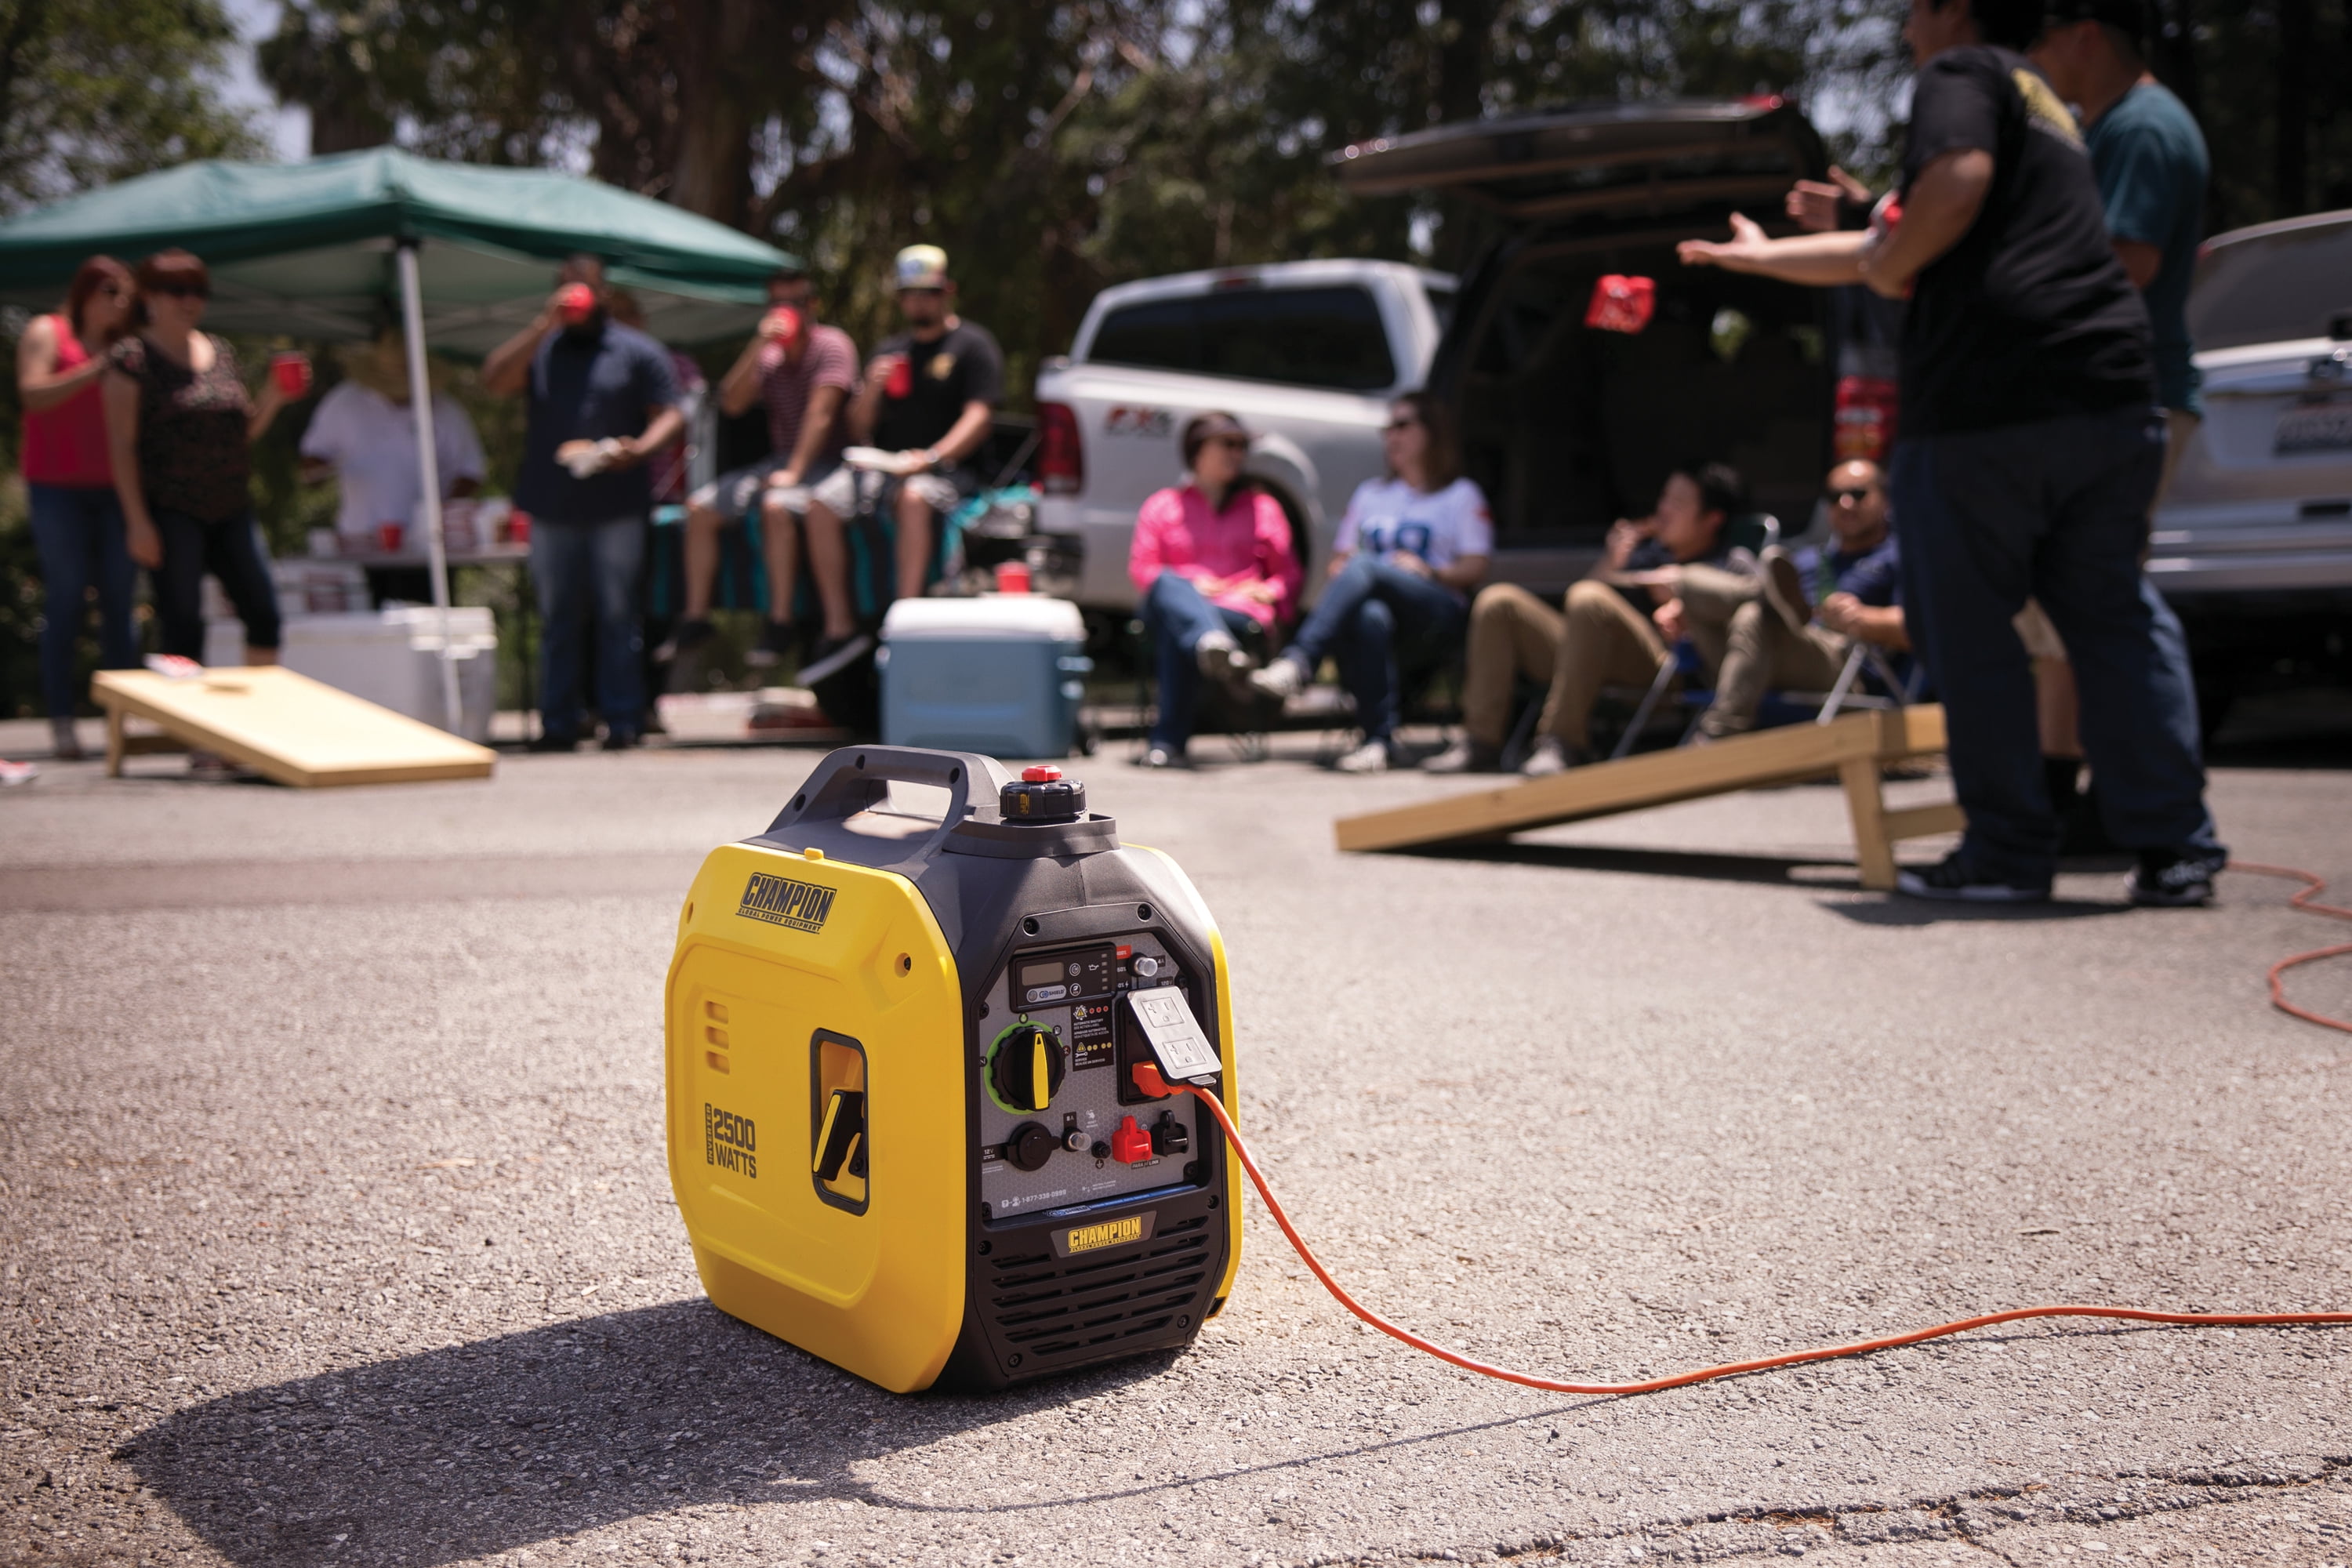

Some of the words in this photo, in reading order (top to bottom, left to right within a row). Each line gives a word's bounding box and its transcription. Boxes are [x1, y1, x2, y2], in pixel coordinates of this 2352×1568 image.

[741, 873, 836, 924] CHAMPION
[739, 908, 760, 917] GLOBAL
[761, 913, 782, 923] POWER
[784, 918, 822, 932] EQUIPMENT
[706, 1103, 714, 1165] INVERTER
[713, 1108, 756, 1152] 2500
[715, 1142, 757, 1179] WATTS
[1069, 1218, 1141, 1247] CHAMPION
